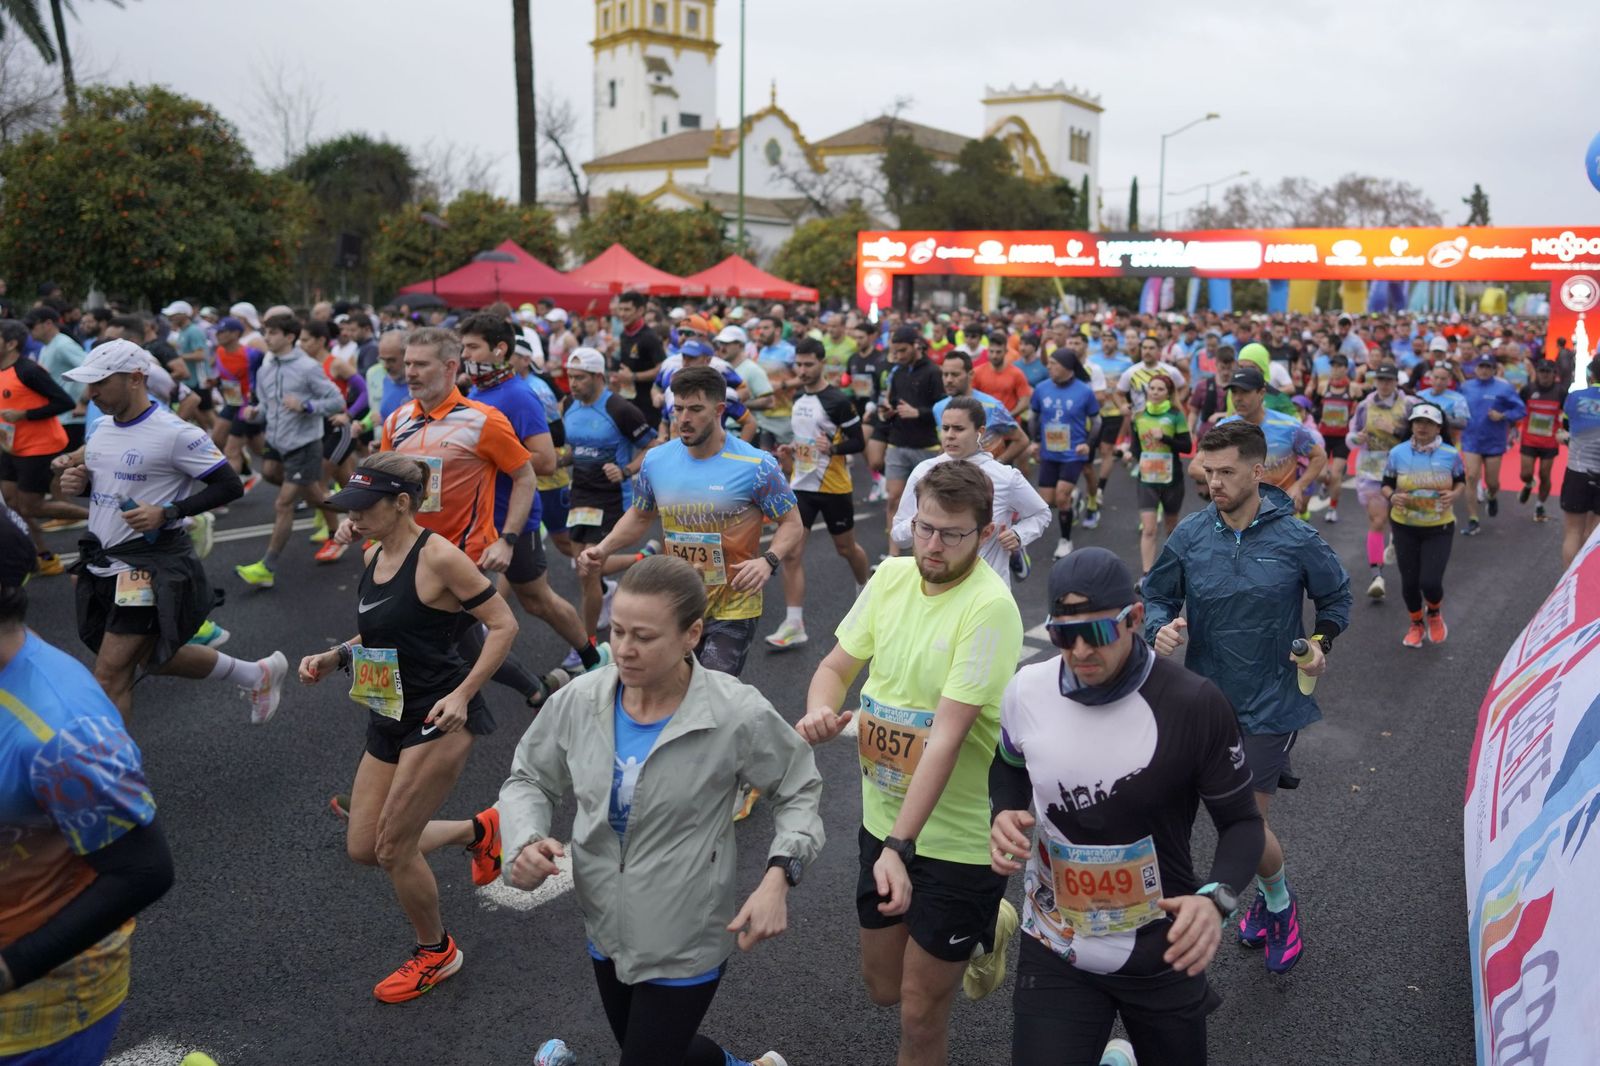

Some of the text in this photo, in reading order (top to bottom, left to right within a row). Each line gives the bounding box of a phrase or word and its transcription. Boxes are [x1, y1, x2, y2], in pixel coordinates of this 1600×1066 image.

[113, 471, 147, 481] YOUNESS
[673, 545, 707, 562] 5473
[358, 663, 390, 689] 9418
[868, 720, 915, 758] 7857
[1501, 681, 1561, 831] CREATE
[1064, 867, 1133, 896] 6949
